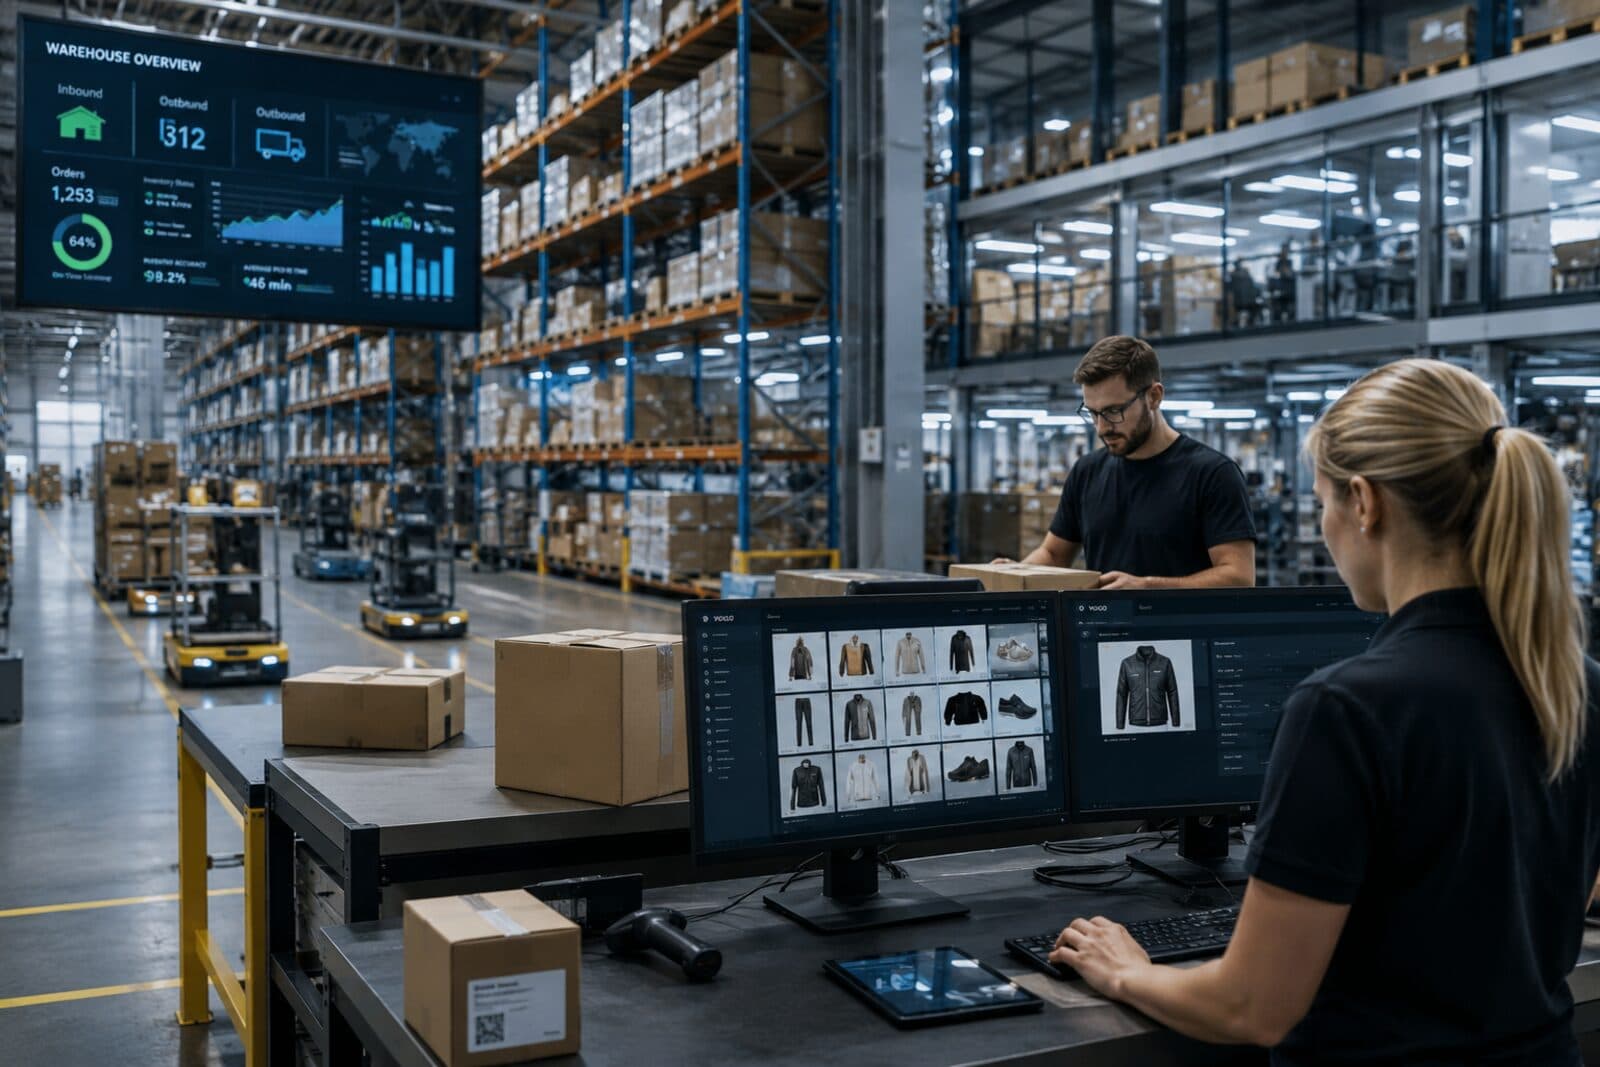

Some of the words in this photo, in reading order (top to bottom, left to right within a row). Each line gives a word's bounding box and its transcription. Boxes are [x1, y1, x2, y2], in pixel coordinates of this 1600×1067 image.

[45, 41, 131, 64] WAREHOUSE
[133, 53, 202, 73] OVERVIEW
[57, 83, 104, 99] Inbound
[256, 106, 306, 122] Outbound
[51, 166, 86, 180] Orders
[51, 185, 95, 204] 1,253
[68, 235, 97, 249] 64%
[144, 270, 187, 285] 98.2%
[268, 277, 293, 292] min
